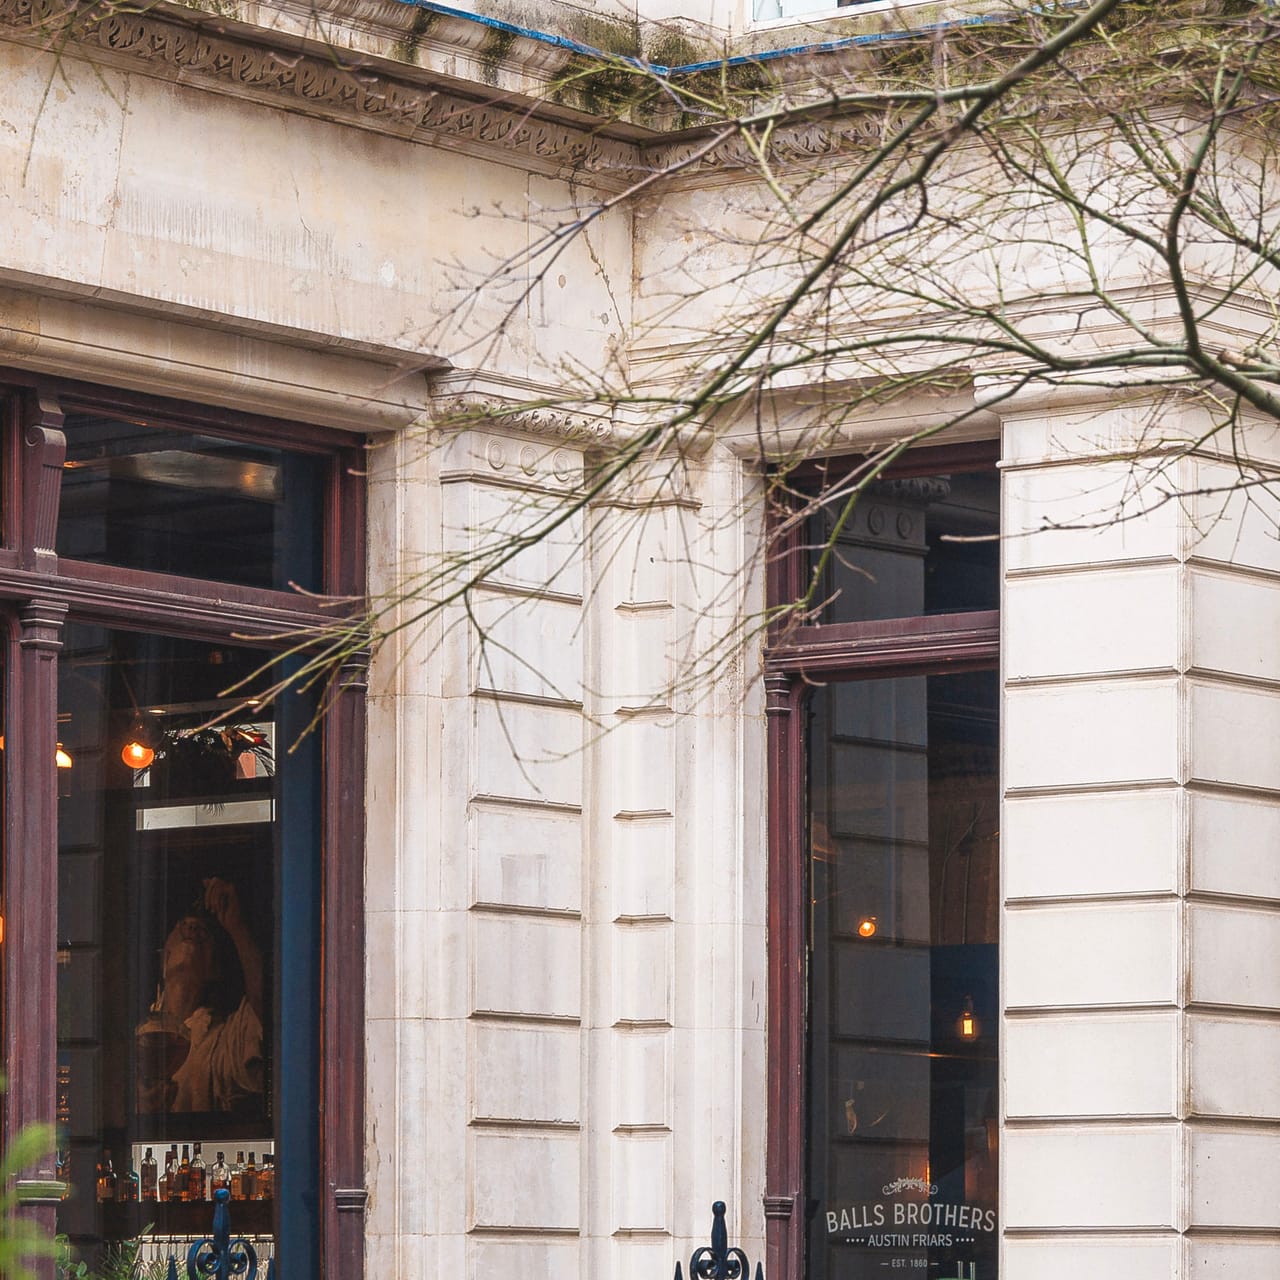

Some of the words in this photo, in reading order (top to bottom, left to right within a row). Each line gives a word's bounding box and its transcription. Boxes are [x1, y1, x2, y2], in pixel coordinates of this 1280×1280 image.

[826, 1204, 885, 1232] BALLS
[894, 1203, 995, 1232] BROTHERS
[868, 1234, 909, 1247] AUSTIN
[913, 1234, 952, 1247] FRIARS
[892, 1259, 907, 1268] EST.
[910, 1259, 928, 1267] 1860
